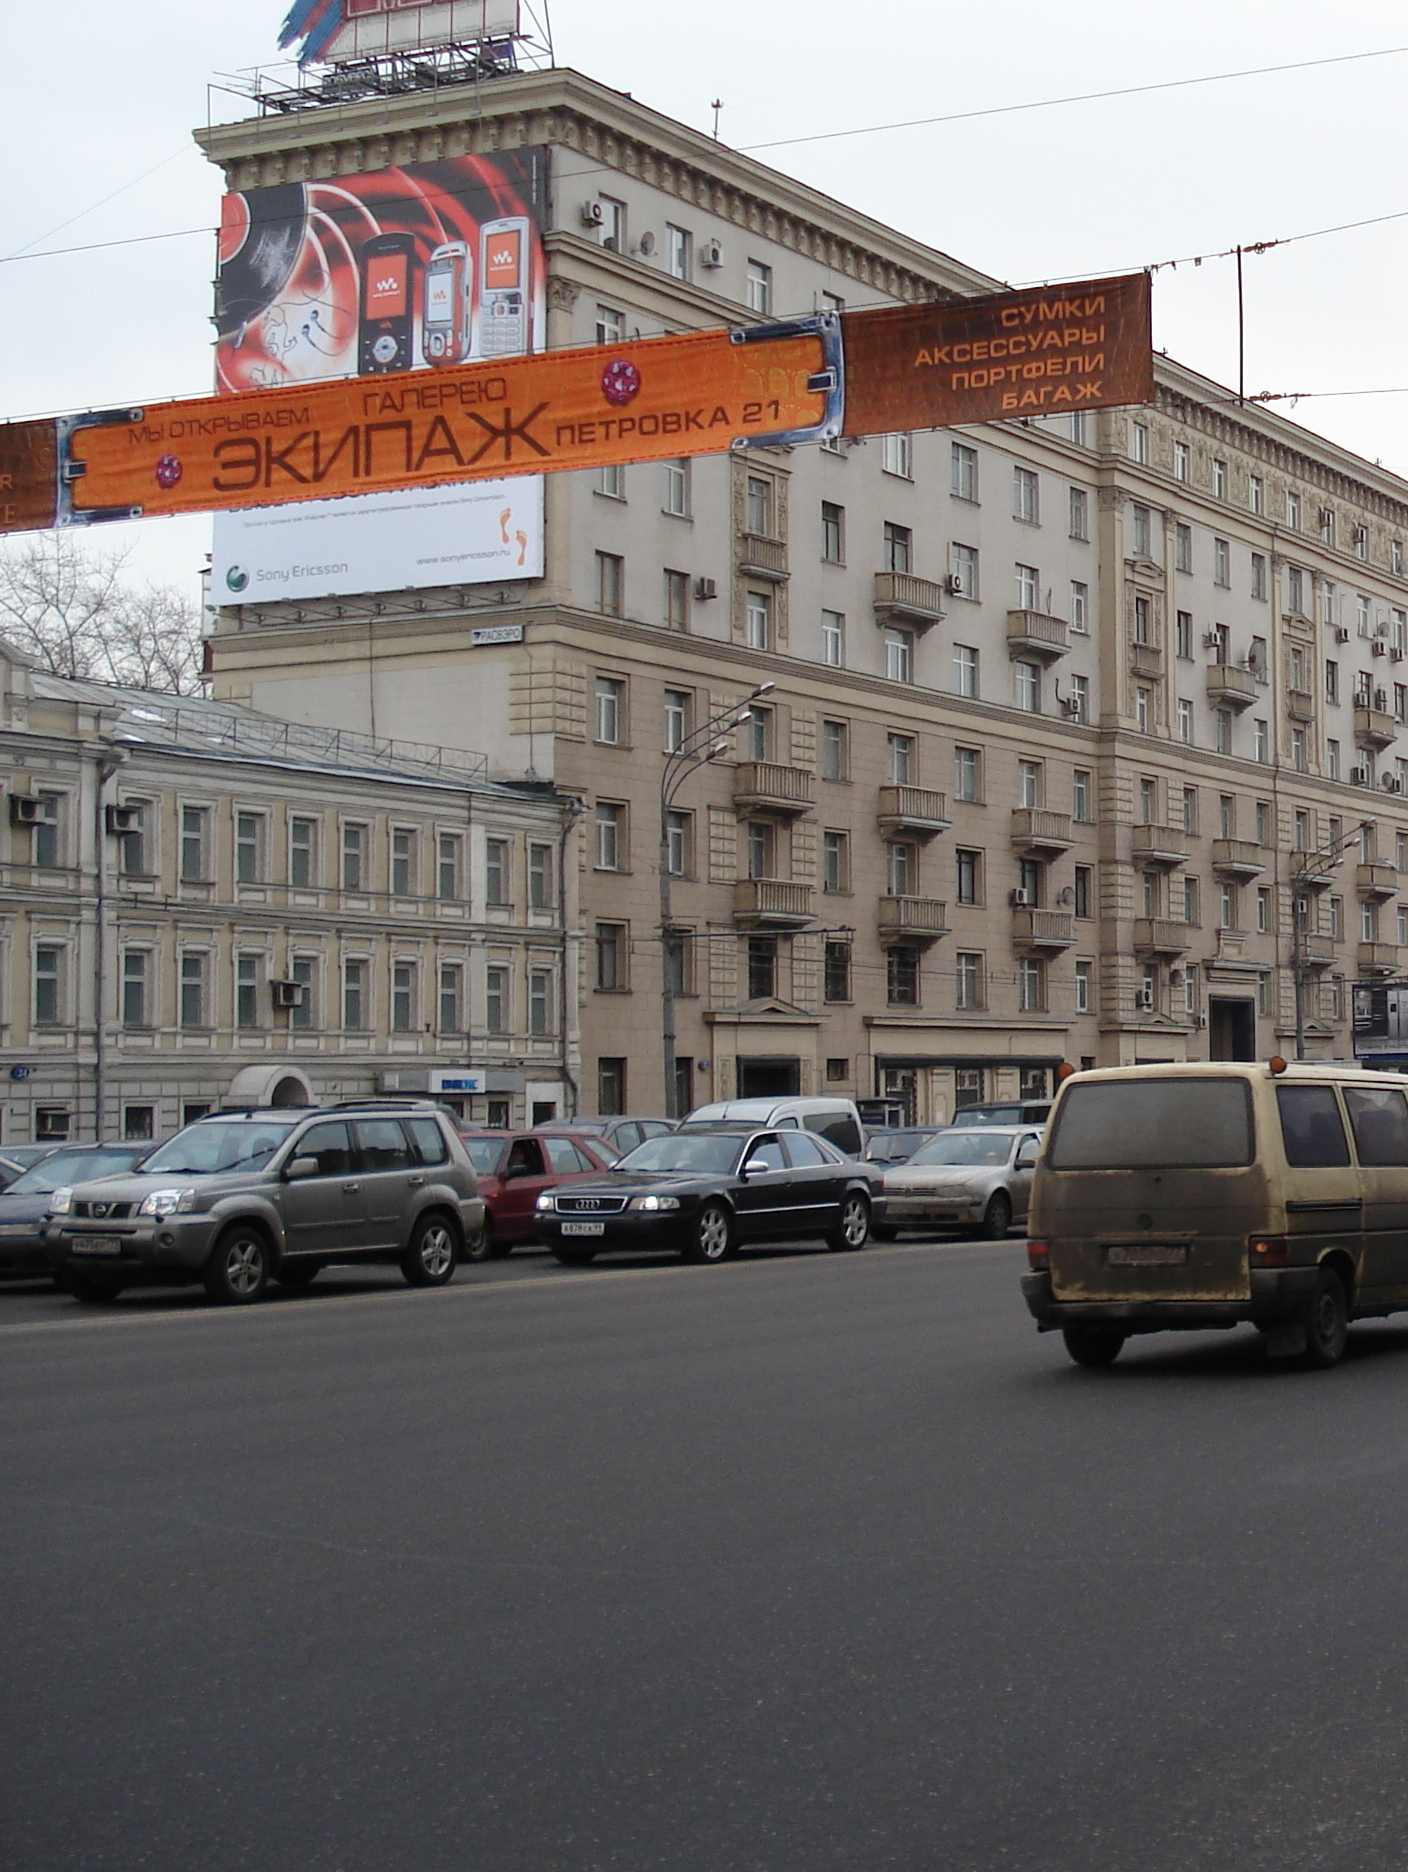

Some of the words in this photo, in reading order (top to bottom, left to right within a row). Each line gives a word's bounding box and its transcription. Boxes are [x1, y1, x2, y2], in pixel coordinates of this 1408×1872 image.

[1001, 296, 1106, 328] СУМКИ
[914, 324, 1105, 367] АКСЕССУАРЫ
[951, 353, 1105, 391] ПОРТФЕЛИ
[128, 424, 165, 445] МЫ
[169, 407, 310, 439] ОТКРЫВАЕМ
[363, 377, 508, 417] ГАЛЕРЕЮ
[1001, 381, 1104, 411] БАГАЖ
[212, 401, 552, 492] ЭКИПАЖ
[555, 406, 731, 447] ПЕТРОВКА
[742, 400, 781, 424] 21
[256, 568, 290, 583] Sony
[292, 562, 349, 578] Ericsson
